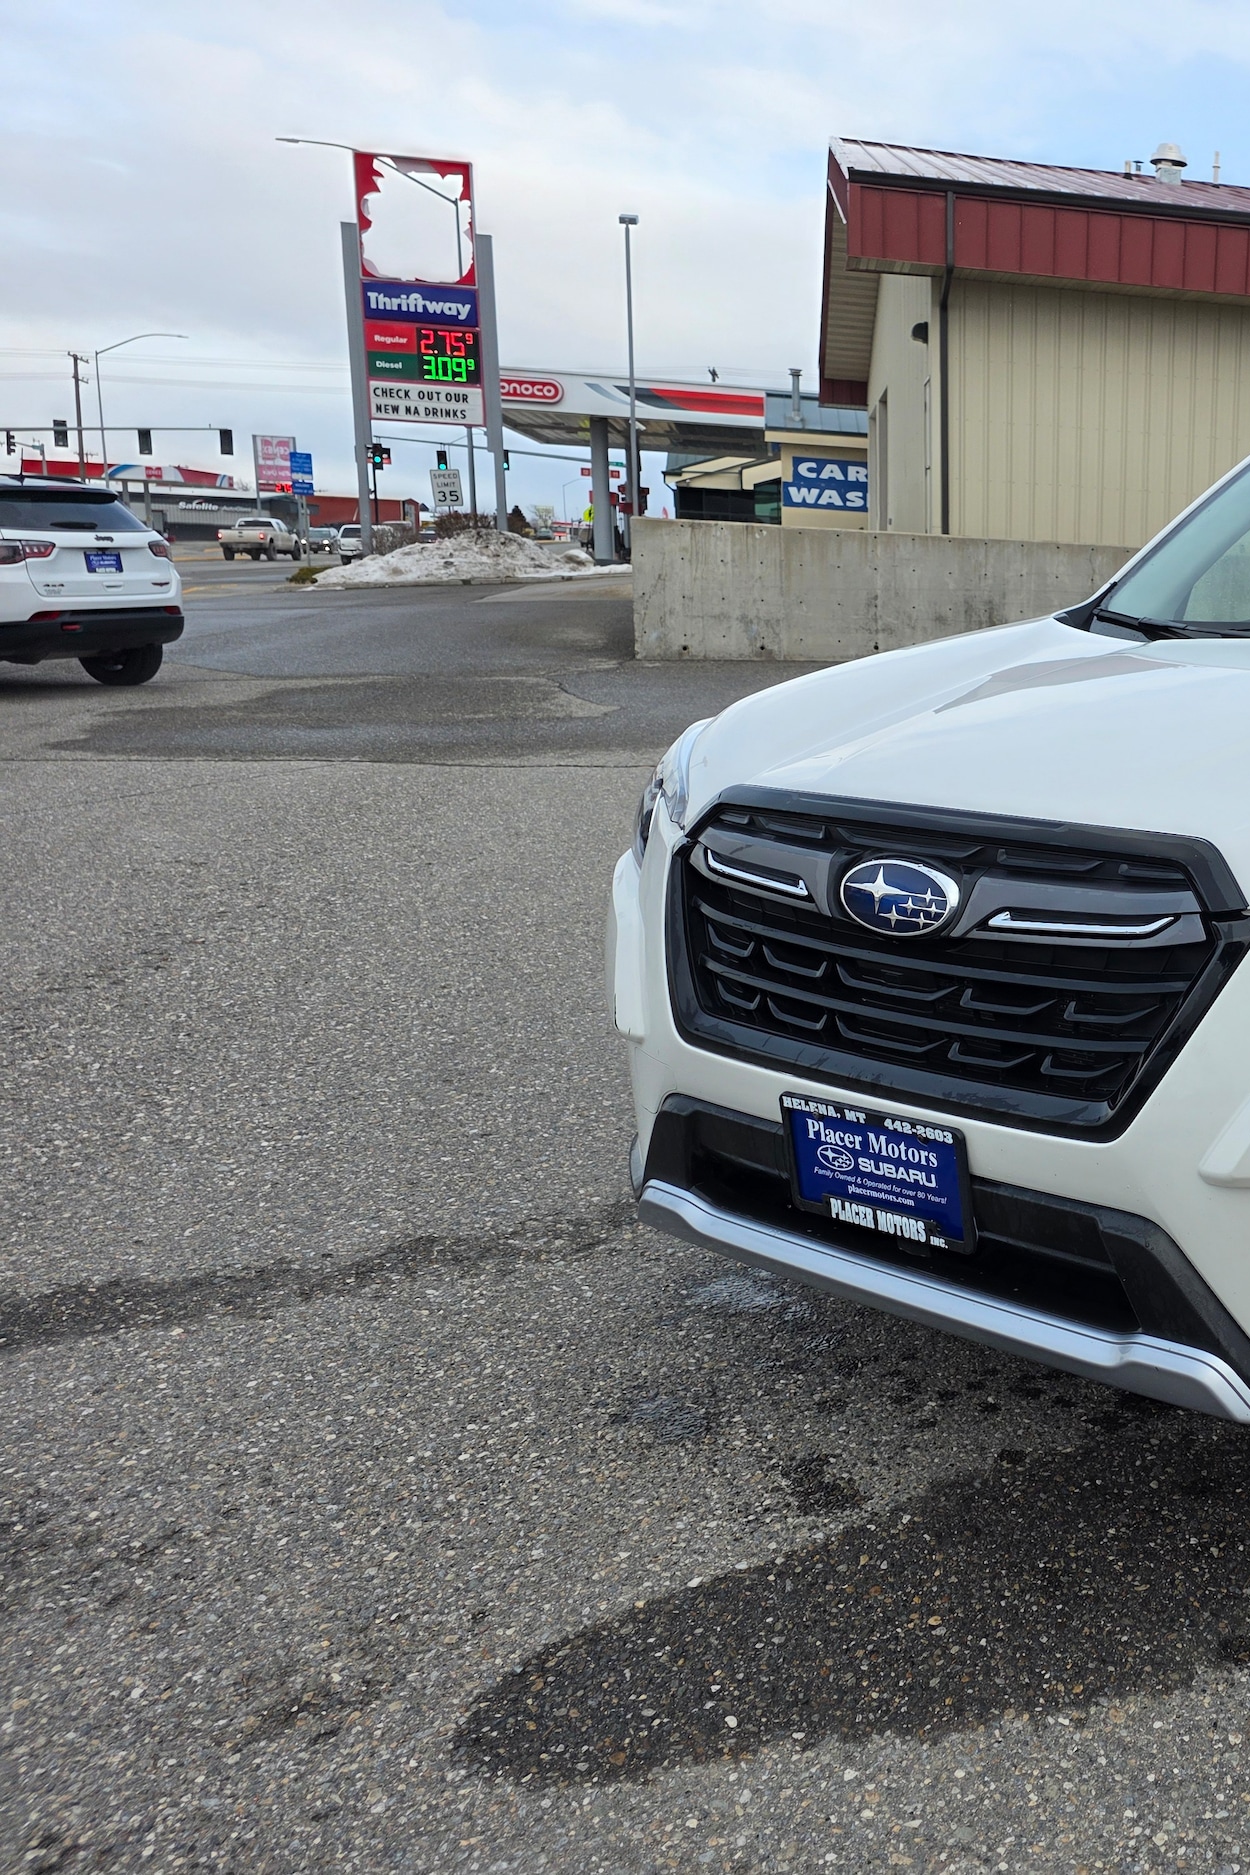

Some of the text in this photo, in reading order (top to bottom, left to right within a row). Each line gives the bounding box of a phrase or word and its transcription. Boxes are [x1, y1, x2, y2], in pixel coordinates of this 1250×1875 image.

[366, 291, 471, 320] Thriftway
[374, 334, 408, 344] Regular
[375, 360, 402, 369] Diesel
[373, 387, 469, 403] CHECK OUT OUR
[500, 381, 556, 397] onoco
[375, 403, 467, 419] NEW NA DRINKS
[797, 461, 867, 482] CAR
[178, 499, 219, 511] Safelite
[438, 491, 459, 502] 35
[788, 486, 867, 507] WAS
[781, 1095, 954, 1144] HELENA, MT 442-2603
[805, 1118, 938, 1167] Placer Motors
[814, 1166, 947, 1205] Family Owned & Operated for over 80 Years!
[847, 1184, 915, 1206] placermotors.com
[829, 1197, 949, 1249] PLACER MOTORS INC.
